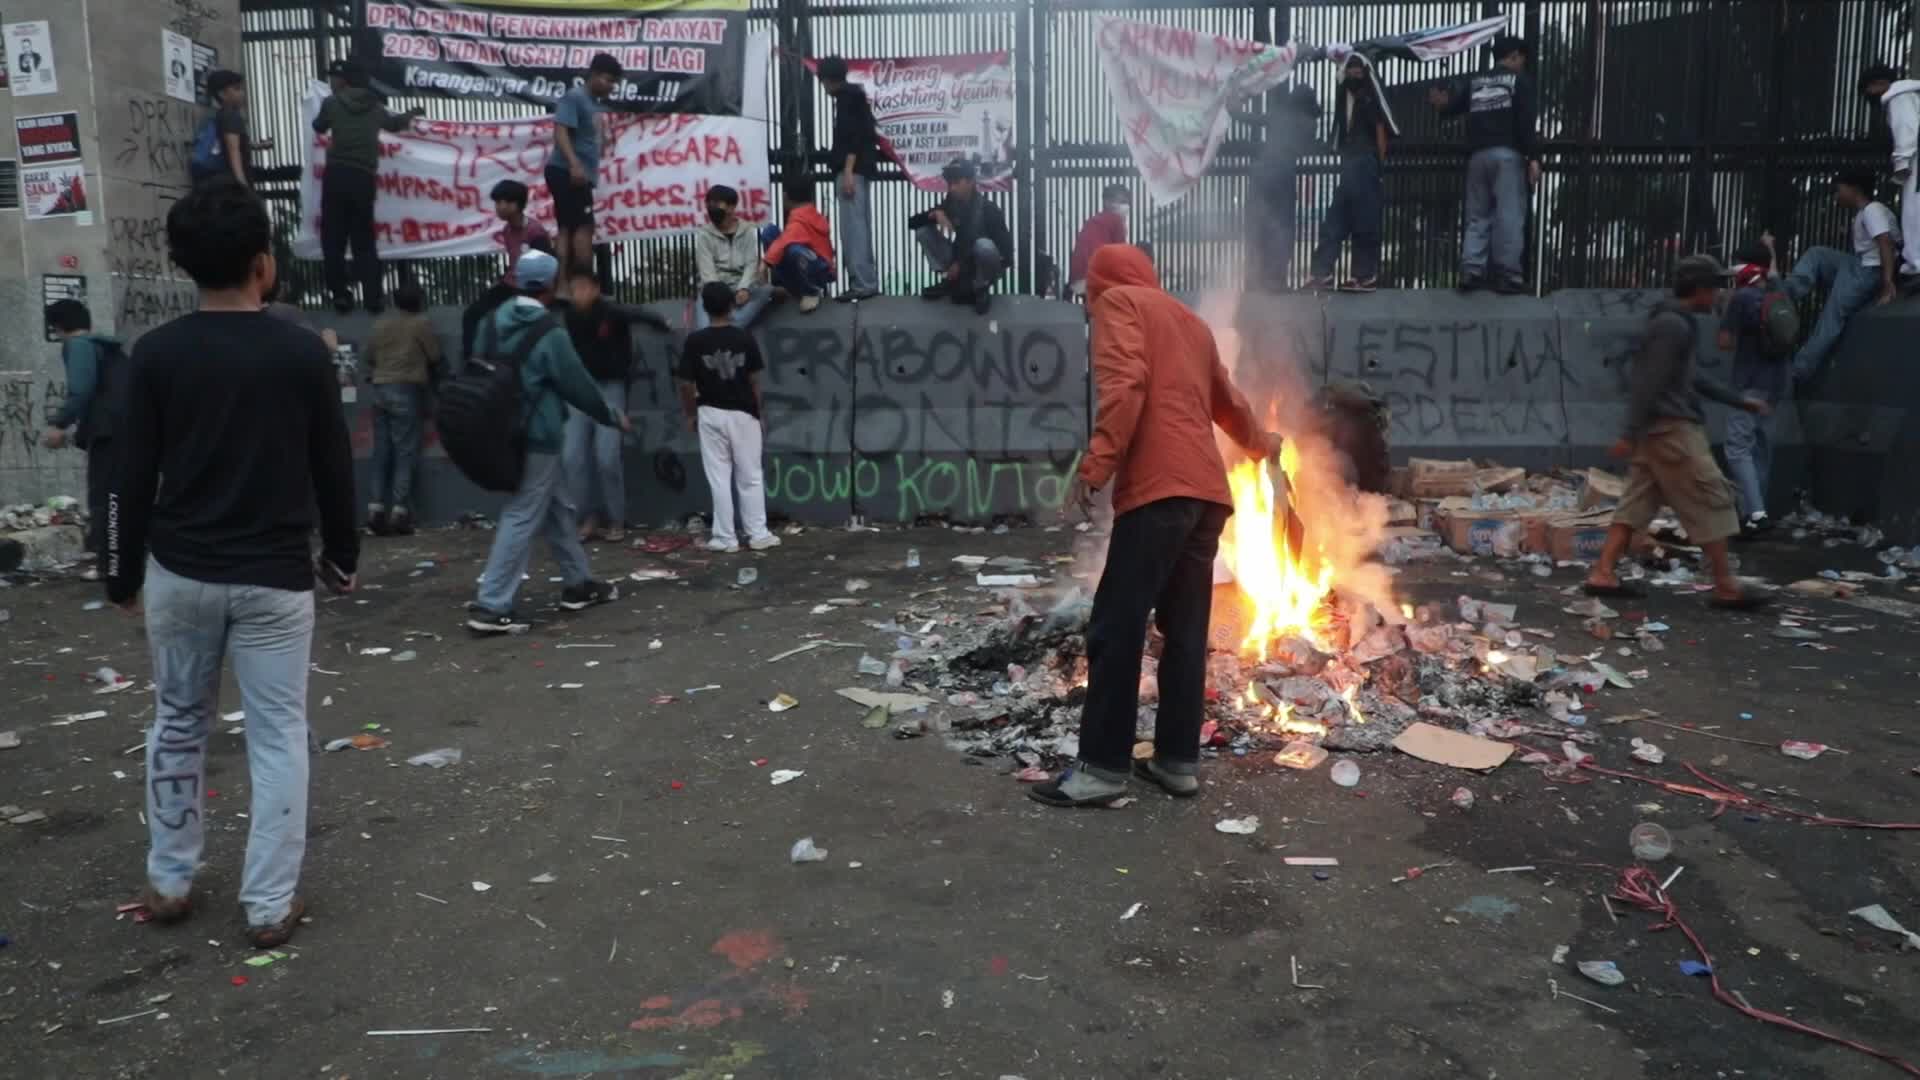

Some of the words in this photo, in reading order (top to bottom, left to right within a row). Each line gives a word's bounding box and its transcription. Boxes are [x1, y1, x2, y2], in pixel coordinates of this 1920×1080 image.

[367, 4, 412, 28] DPR
[413, 8, 488, 36] DEWAN
[491, 14, 641, 42] PENGKHIANAT
[643, 18, 727, 44] RAKYAT
[383, 34, 440, 60] 2029
[441, 38, 506, 66] TIDAK
[507, 43, 566, 67] USAH
[653, 48, 705, 73] LAGI
[405, 65, 528, 96] Karanganyar
[872, 61, 943, 88] Urang
[868, 86, 946, 112] kasbitung
[765, 326, 1065, 393] PRABOWO
[107, 492, 119, 550] LOOKING
